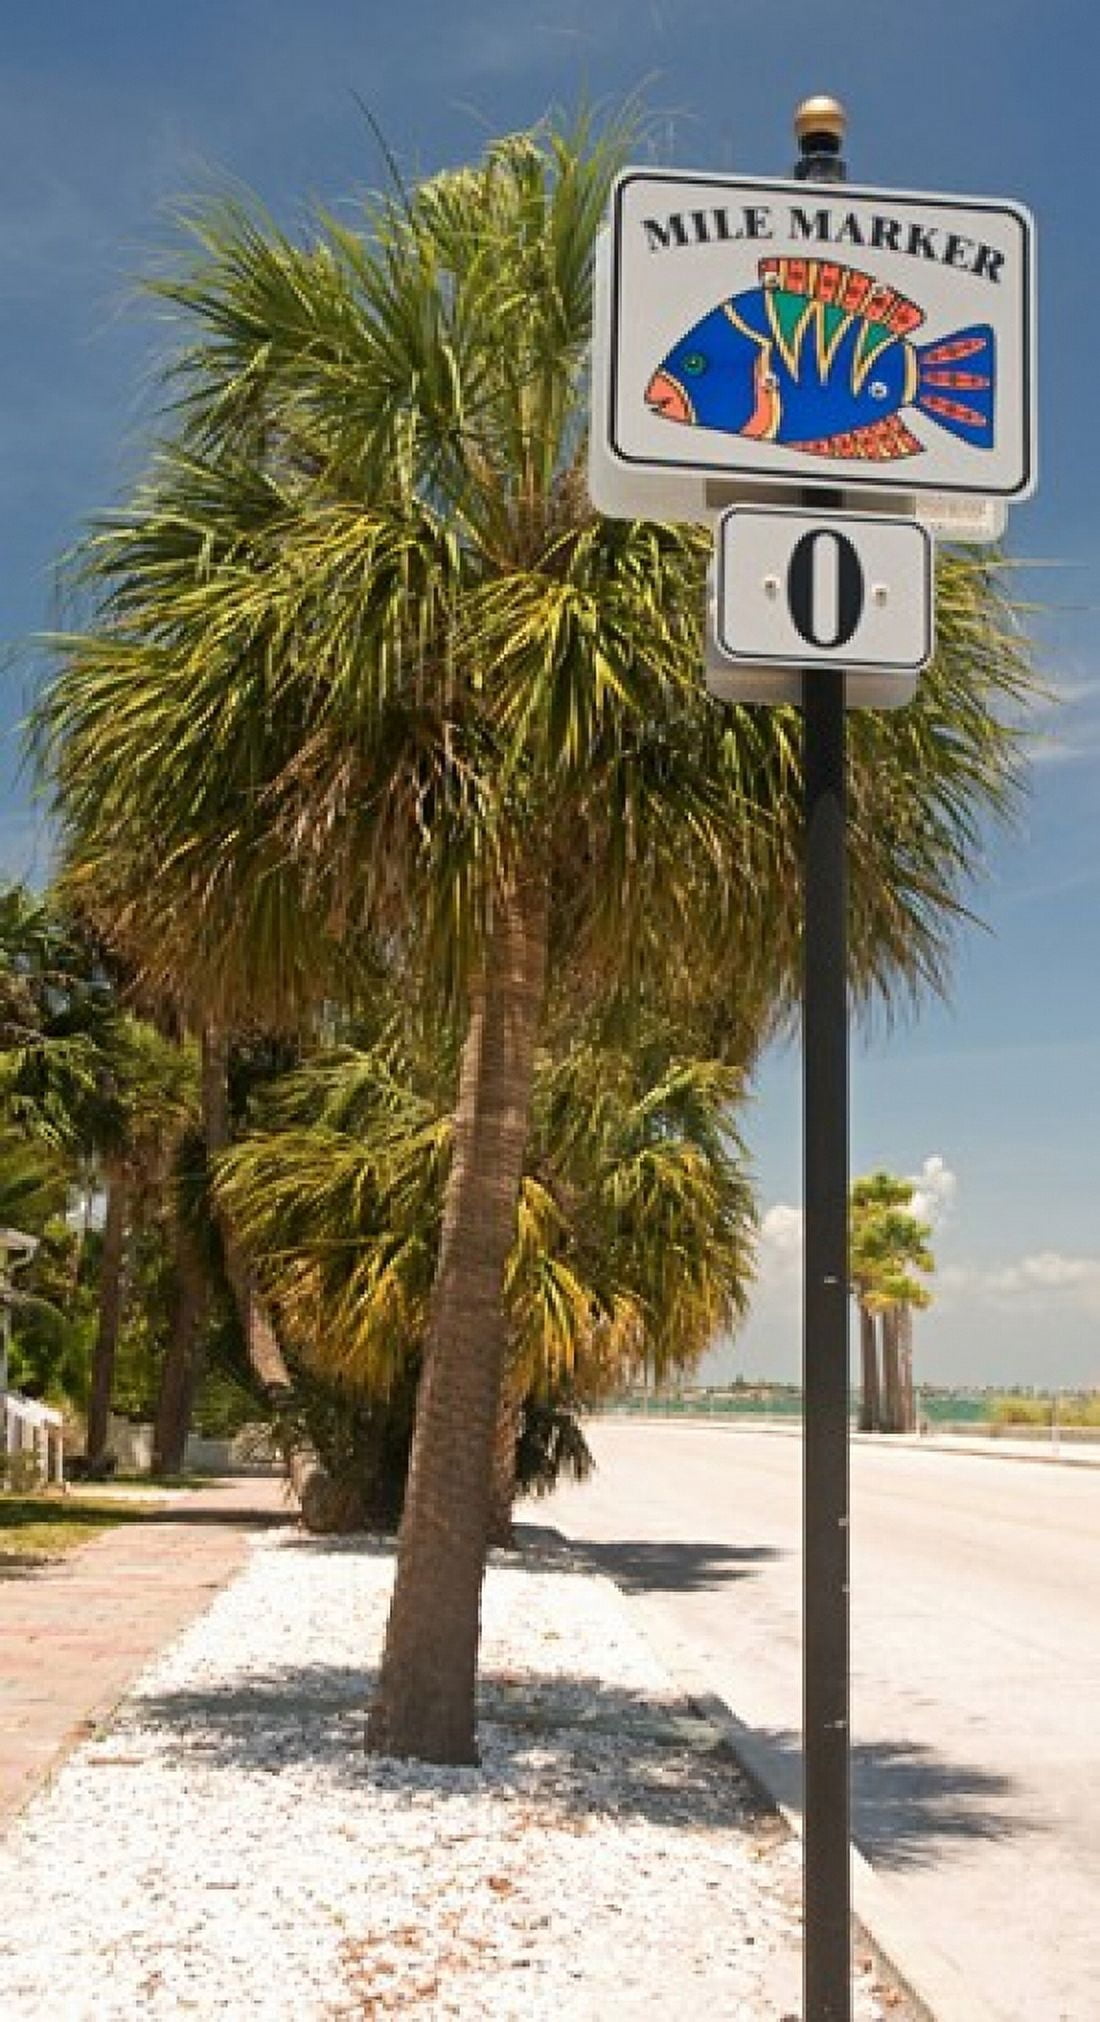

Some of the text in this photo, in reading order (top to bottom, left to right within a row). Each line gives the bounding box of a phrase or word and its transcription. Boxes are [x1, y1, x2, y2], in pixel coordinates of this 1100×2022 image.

[642, 206, 1005, 284] MILE MARKER
[787, 527, 864, 649] 0
